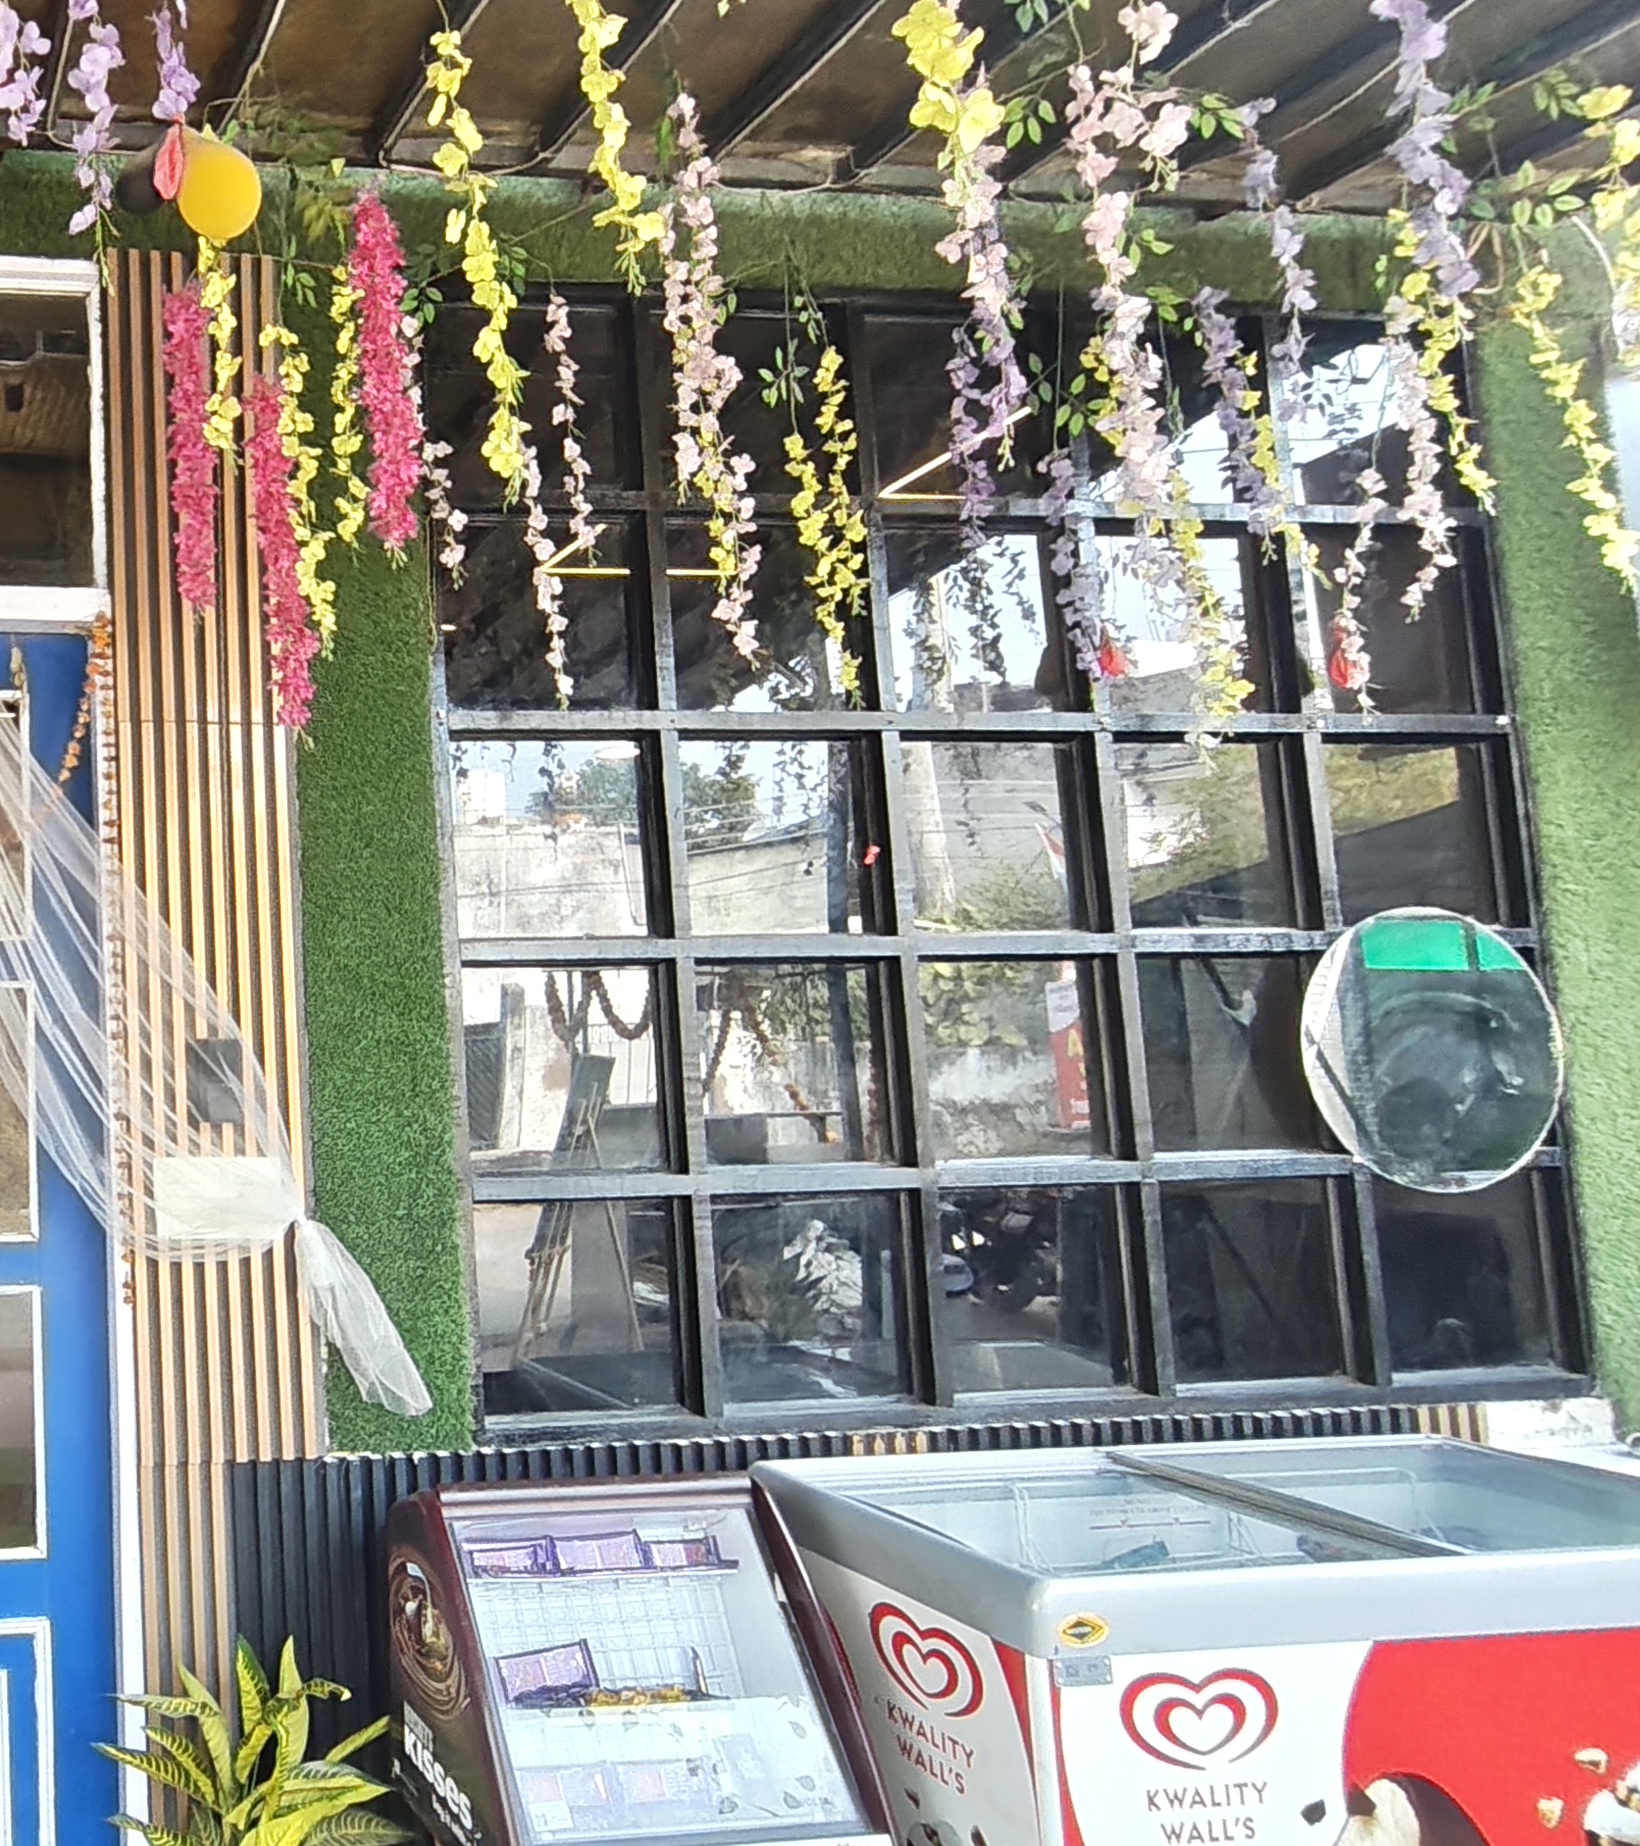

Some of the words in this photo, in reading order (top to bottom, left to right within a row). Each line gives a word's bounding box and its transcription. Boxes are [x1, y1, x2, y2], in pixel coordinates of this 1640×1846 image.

[886, 1700, 974, 1768] KWALITY
[896, 1734, 966, 1795] WALL'S
[1146, 1781, 1267, 1812] KWALITY
[1160, 1817, 1255, 1845] WALL'S
